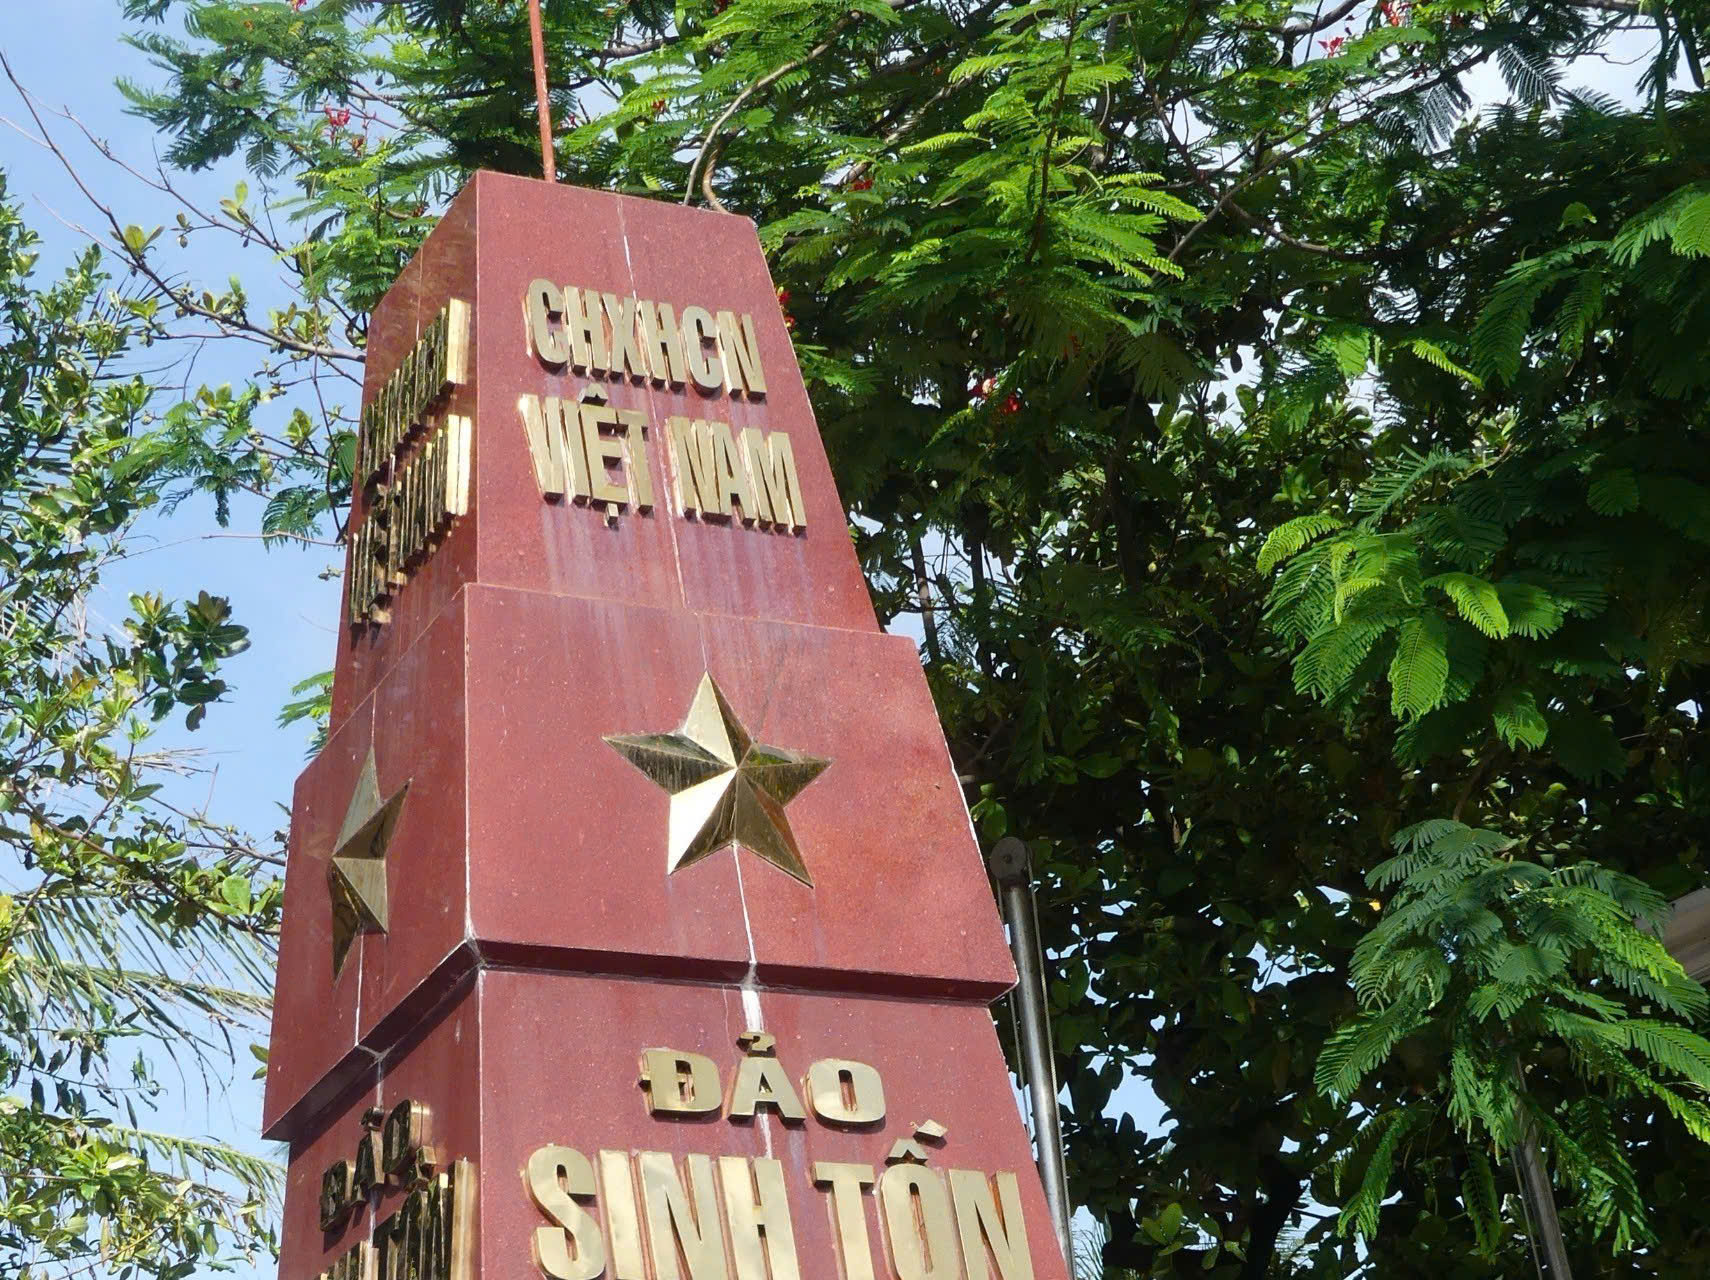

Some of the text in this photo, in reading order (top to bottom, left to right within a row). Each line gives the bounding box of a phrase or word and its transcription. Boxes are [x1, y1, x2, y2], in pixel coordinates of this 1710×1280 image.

[522, 278, 767, 401] CHXHCN
[518, 384, 654, 529] VIỆT
[666, 416, 807, 536] NAM
[638, 1032, 887, 1125] ĐẢO
